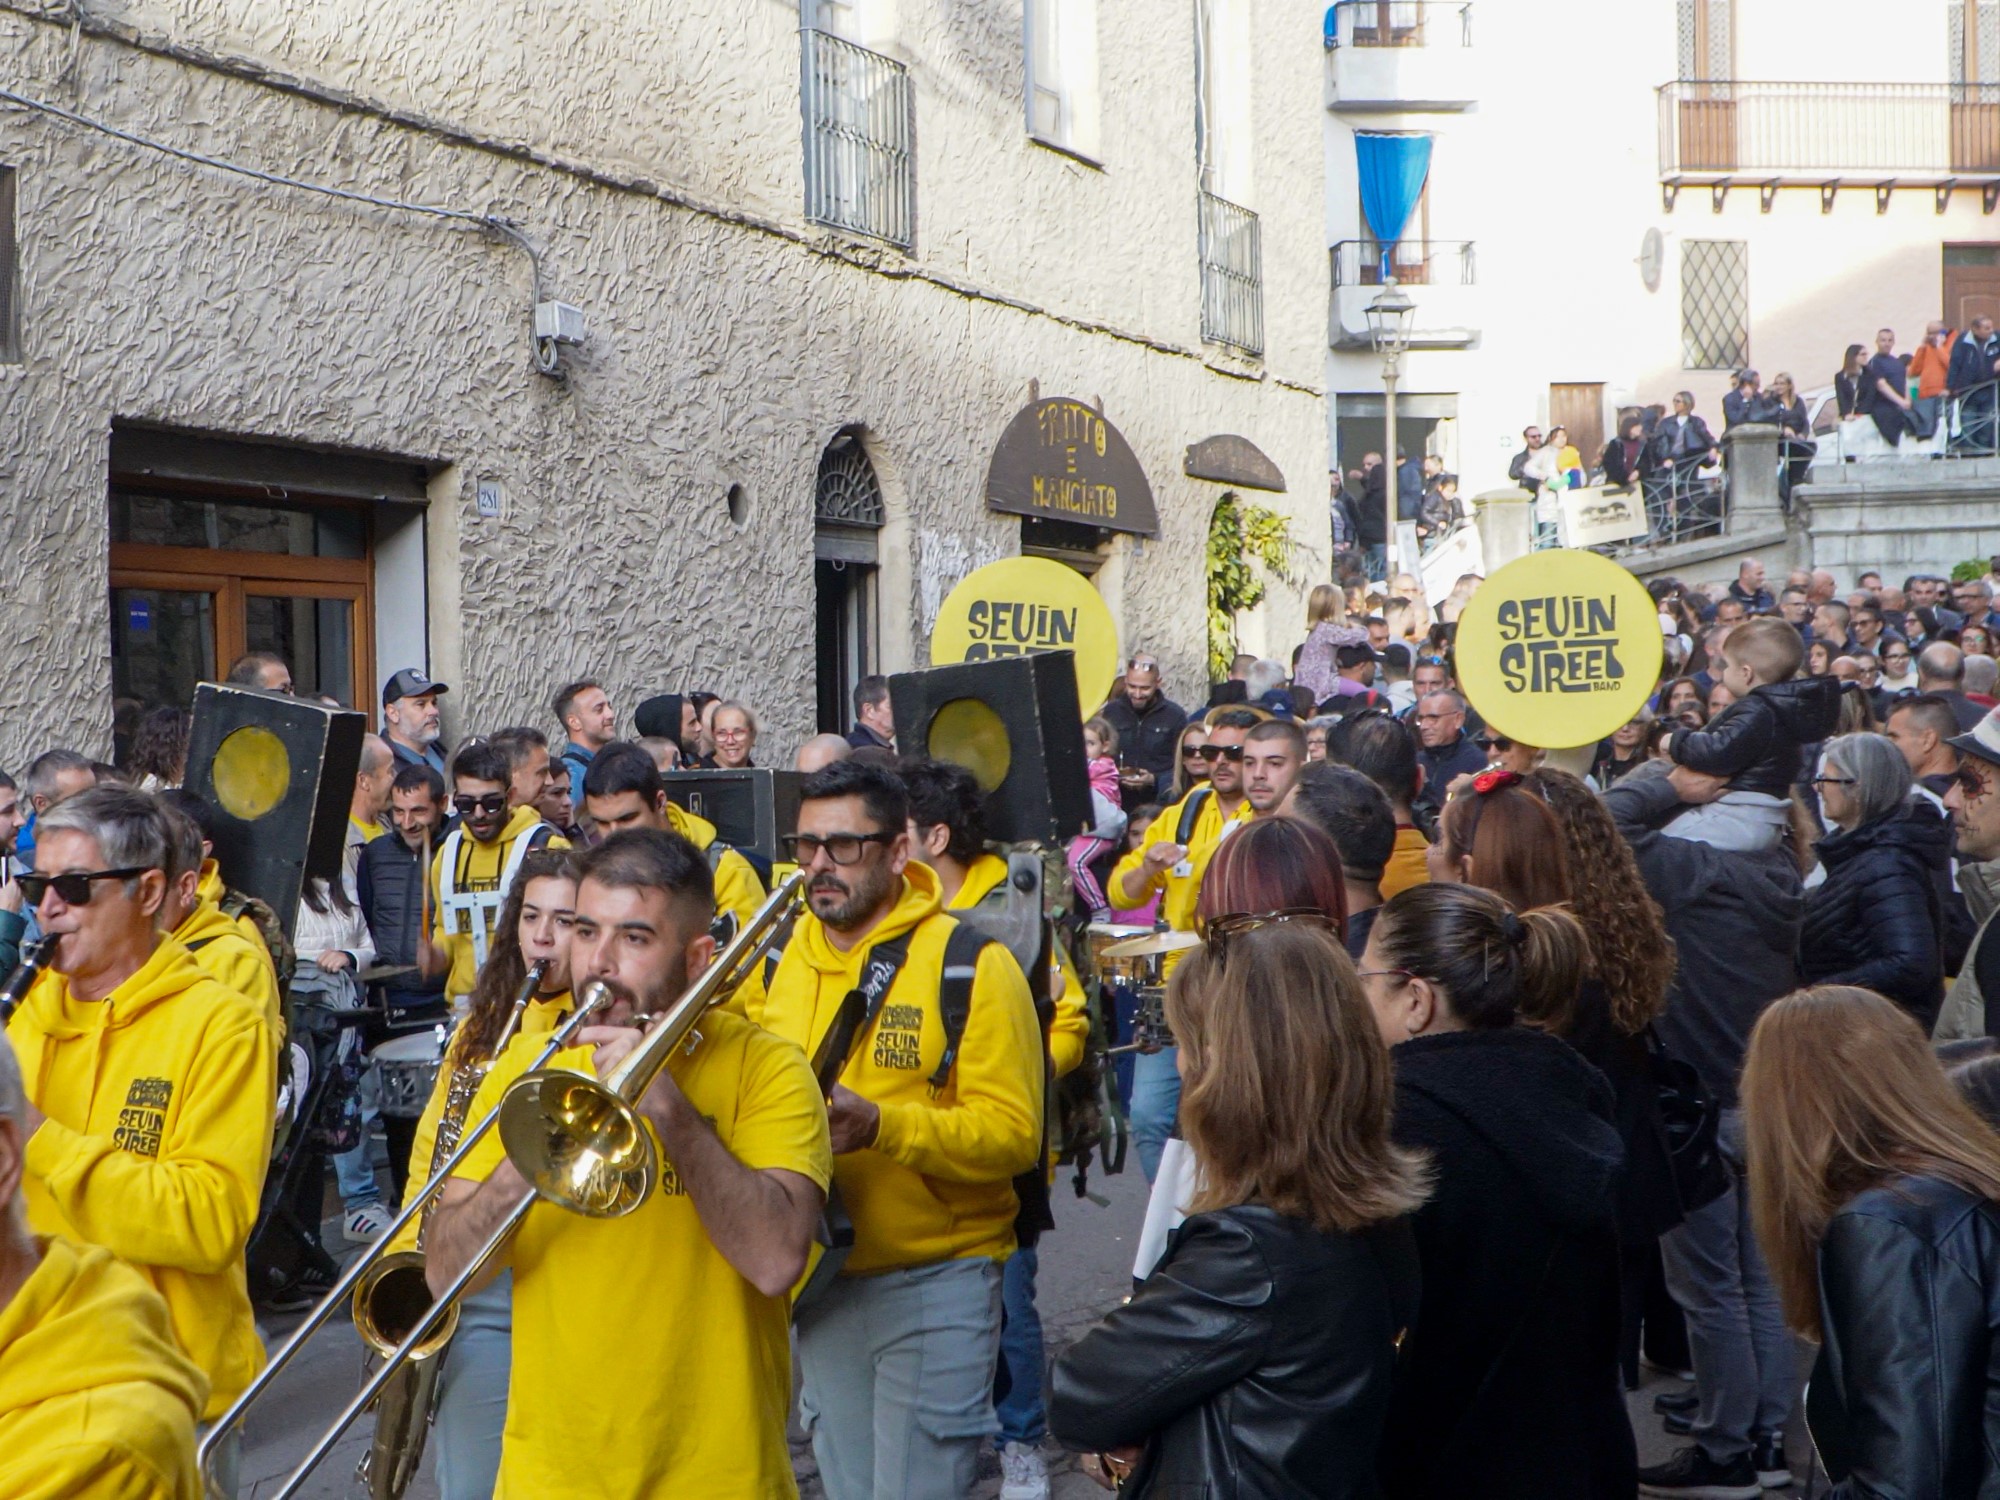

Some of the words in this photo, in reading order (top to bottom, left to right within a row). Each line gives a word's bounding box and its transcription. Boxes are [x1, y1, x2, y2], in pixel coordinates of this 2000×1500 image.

[481, 489, 497, 509] 281
[1499, 638, 1625, 693] STREET
[1593, 681, 1621, 691] BAND
